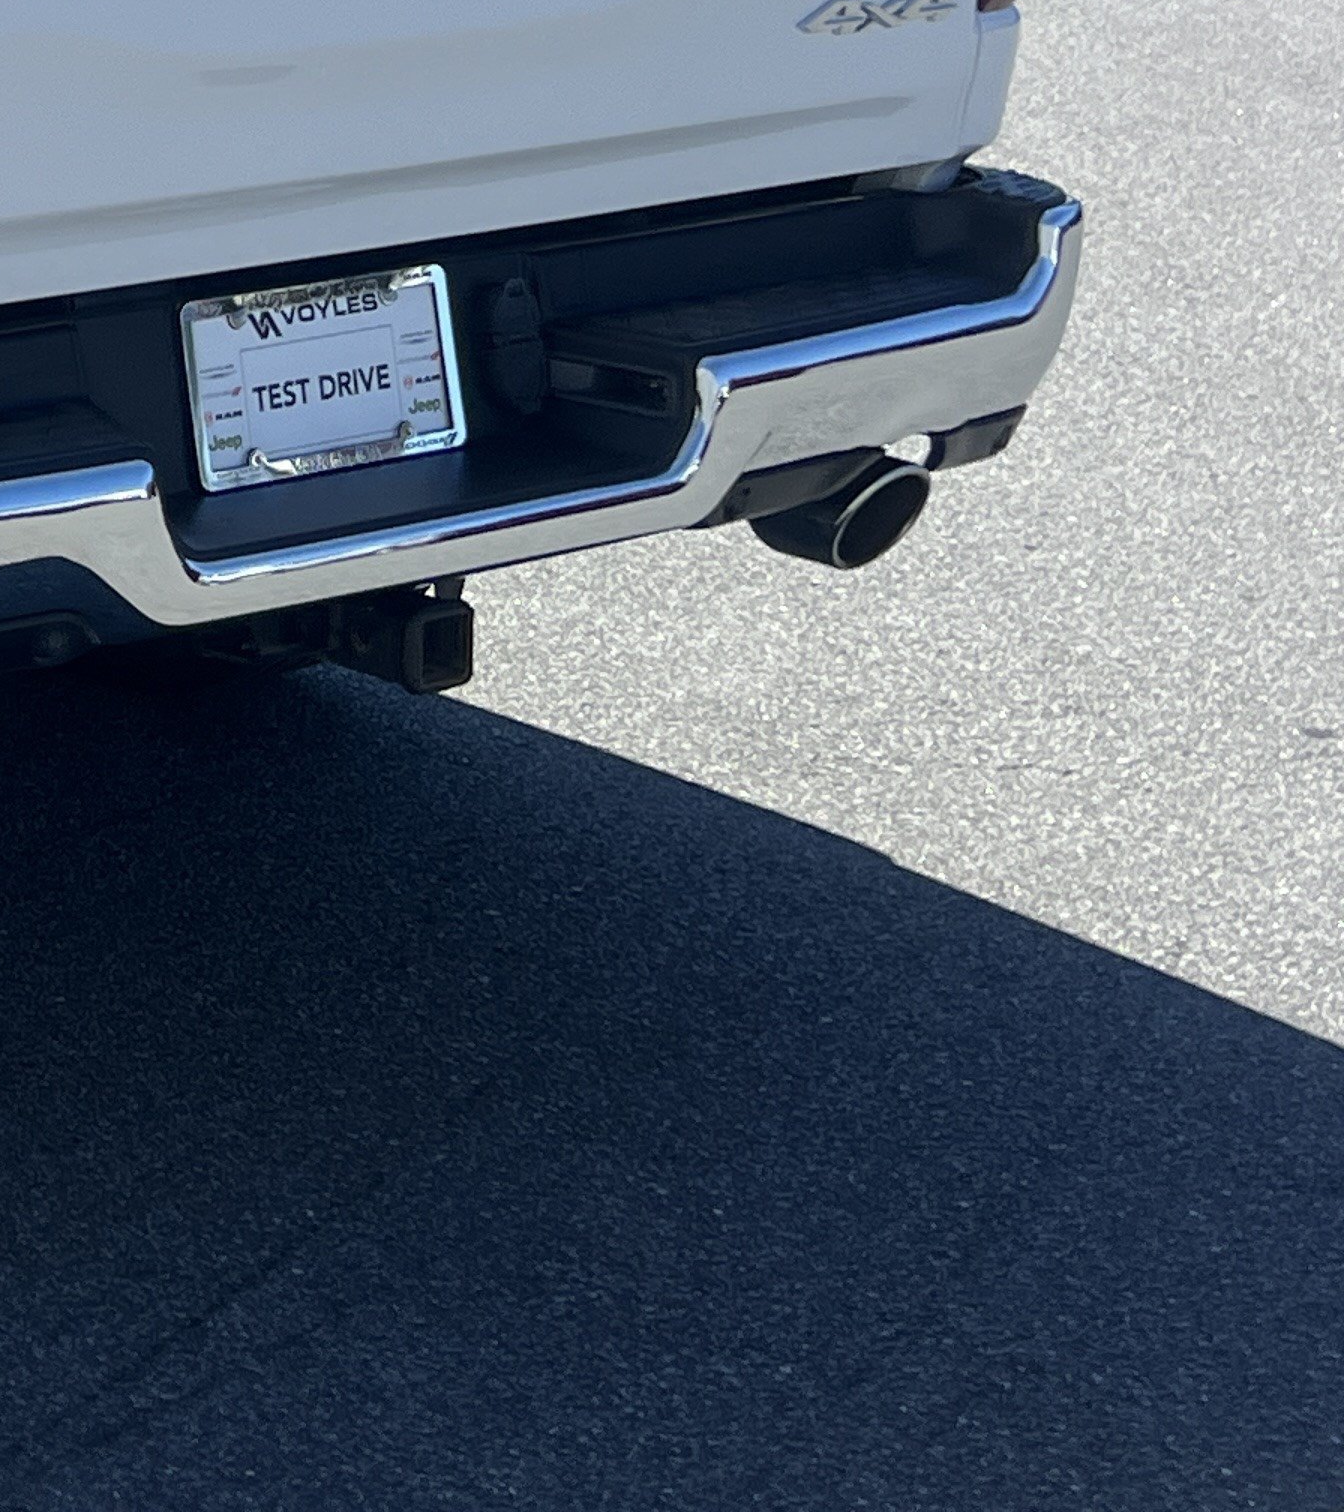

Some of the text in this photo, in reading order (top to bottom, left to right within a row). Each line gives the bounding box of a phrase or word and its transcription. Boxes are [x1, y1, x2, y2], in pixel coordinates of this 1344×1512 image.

[280, 292, 379, 326] VOYLES
[252, 363, 392, 412] TEST DRIVE
[408, 397, 441, 414] Jeep
[208, 434, 242, 452] Jeep
